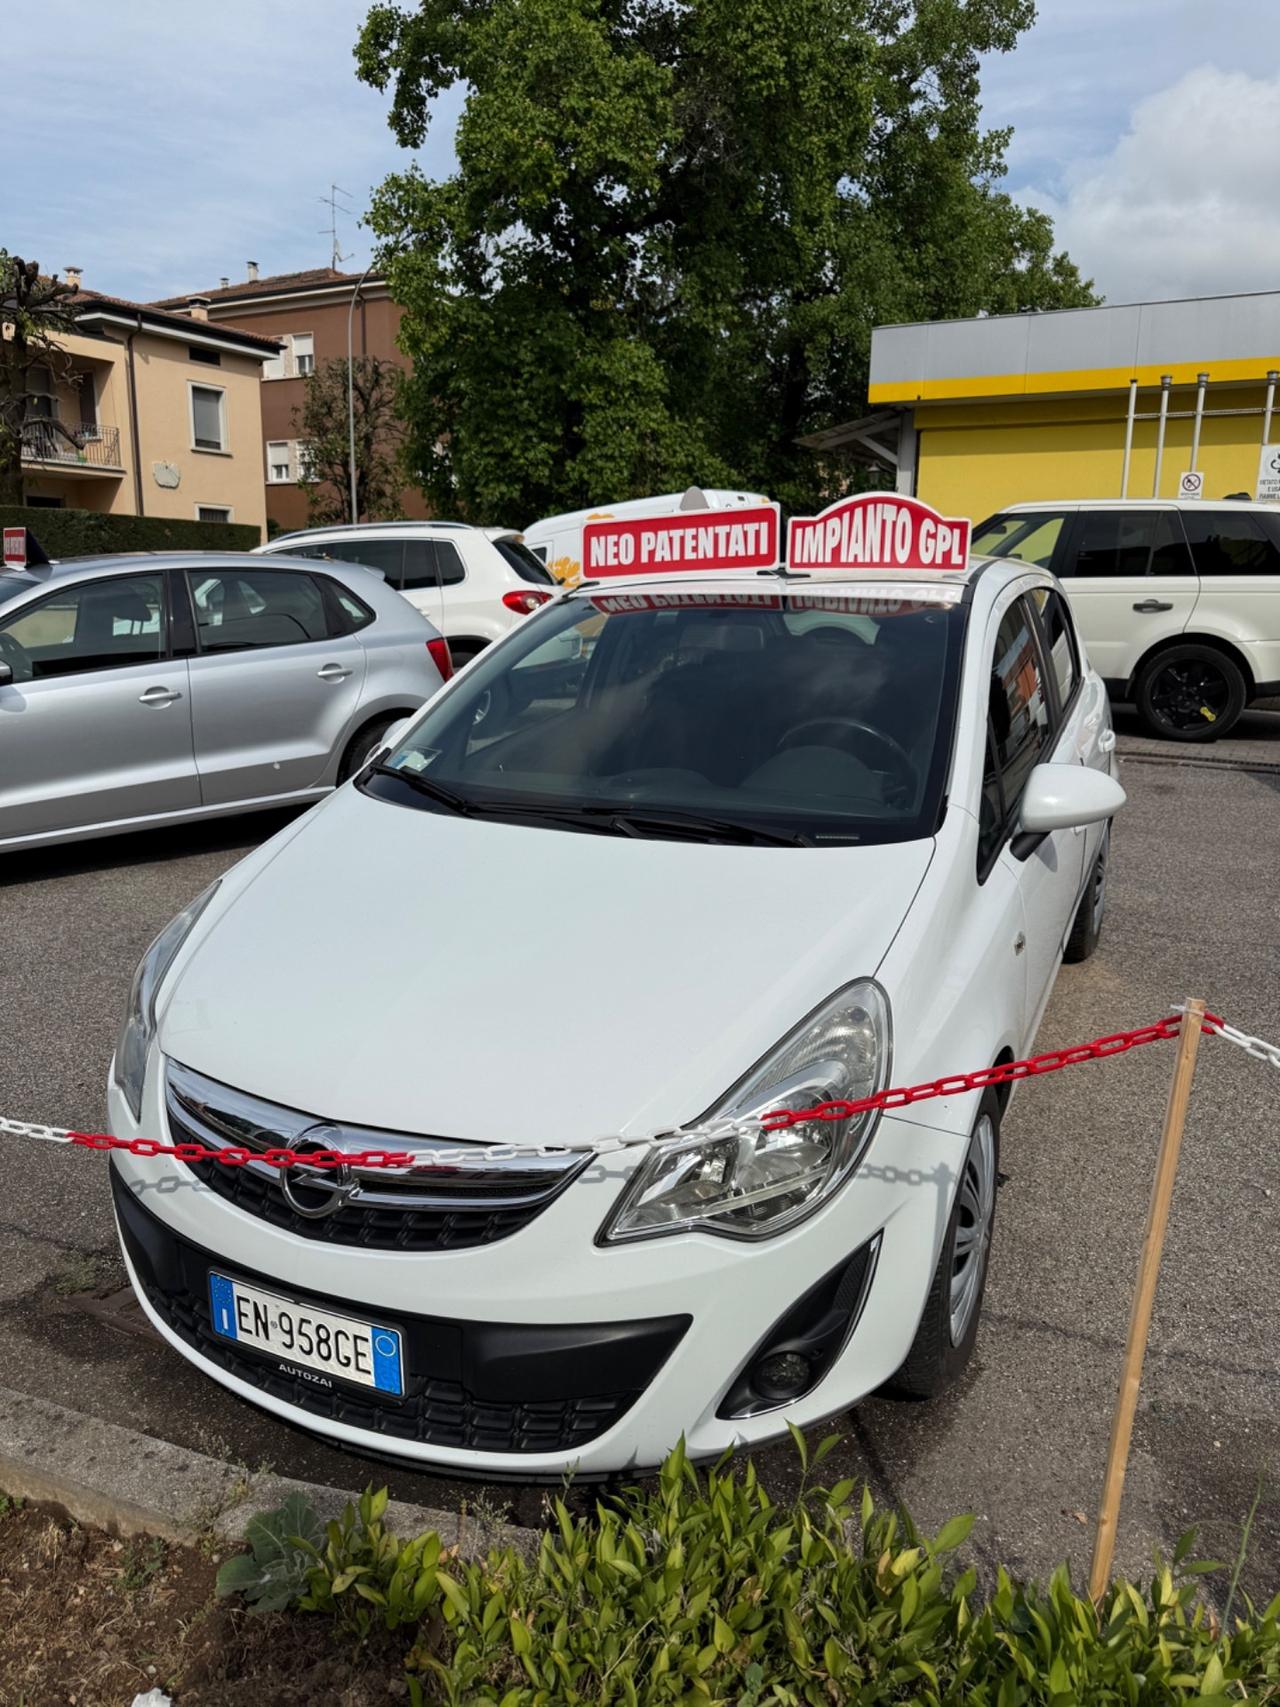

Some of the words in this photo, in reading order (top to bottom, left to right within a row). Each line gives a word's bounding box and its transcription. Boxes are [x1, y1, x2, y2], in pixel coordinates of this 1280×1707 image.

[590, 533, 635, 568] NEO
[640, 521, 769, 564] PATENTATI
[794, 504, 913, 565] IMPIANTO
[919, 518, 965, 565] GPL
[278, 1363, 332, 1388] AUTOZAI
